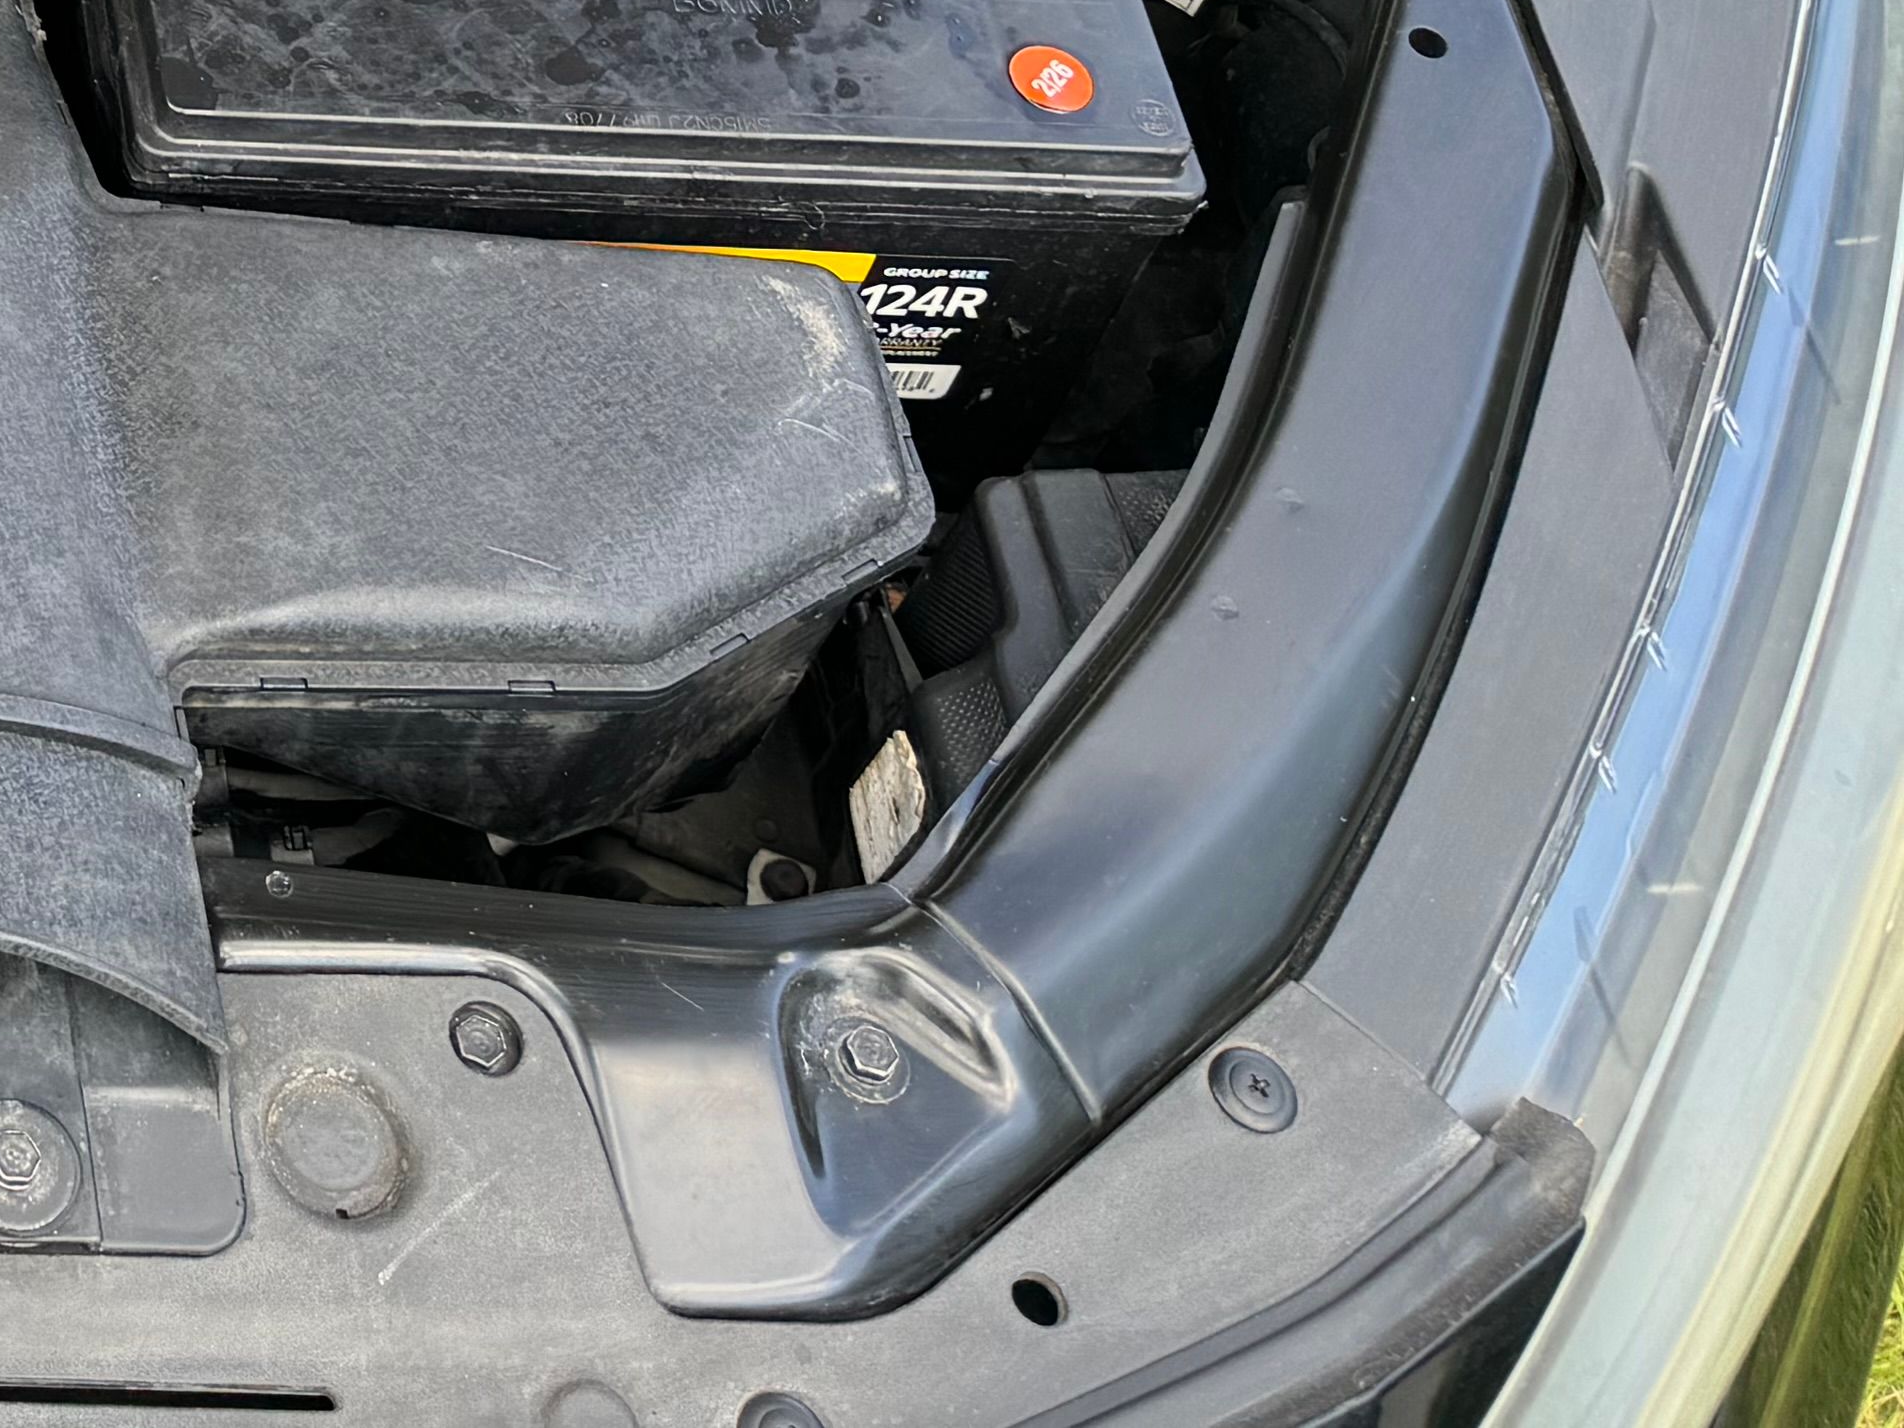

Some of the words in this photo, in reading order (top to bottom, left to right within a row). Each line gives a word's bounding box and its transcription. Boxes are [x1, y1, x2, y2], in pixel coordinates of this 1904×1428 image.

[1031, 58, 1075, 98] 2/26
[883, 267, 949, 279] GROUP
[948, 269, 990, 281] SIZE
[860, 283, 989, 319] 124R
[873, 322, 963, 340] -Year
